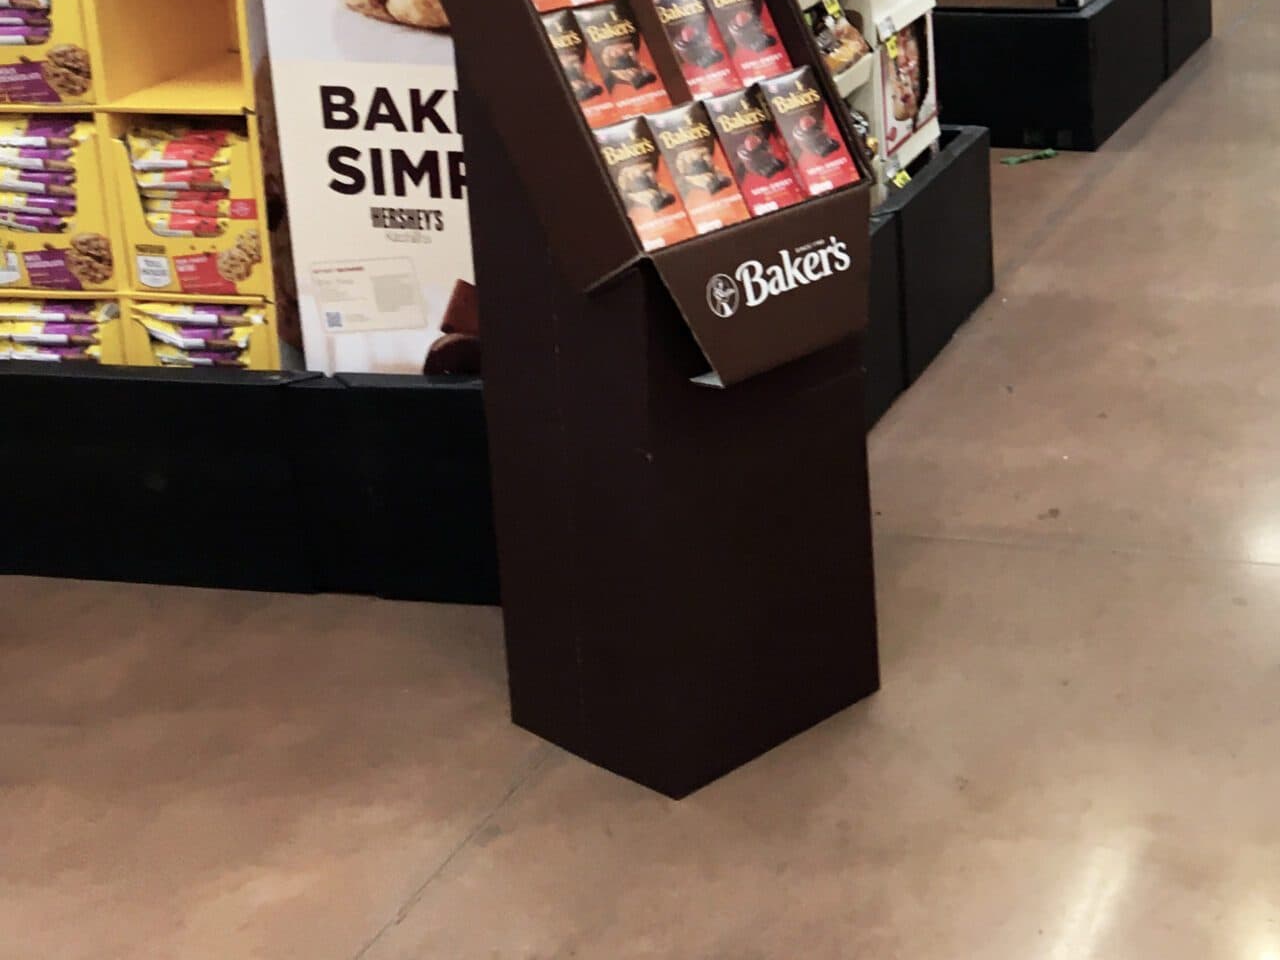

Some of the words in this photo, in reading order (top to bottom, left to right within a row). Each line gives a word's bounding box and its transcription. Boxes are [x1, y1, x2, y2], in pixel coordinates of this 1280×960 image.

[320, 86, 463, 136] BAK
[371, 206, 444, 231] HERSHEY'S
[735, 235, 851, 307] Baker's
